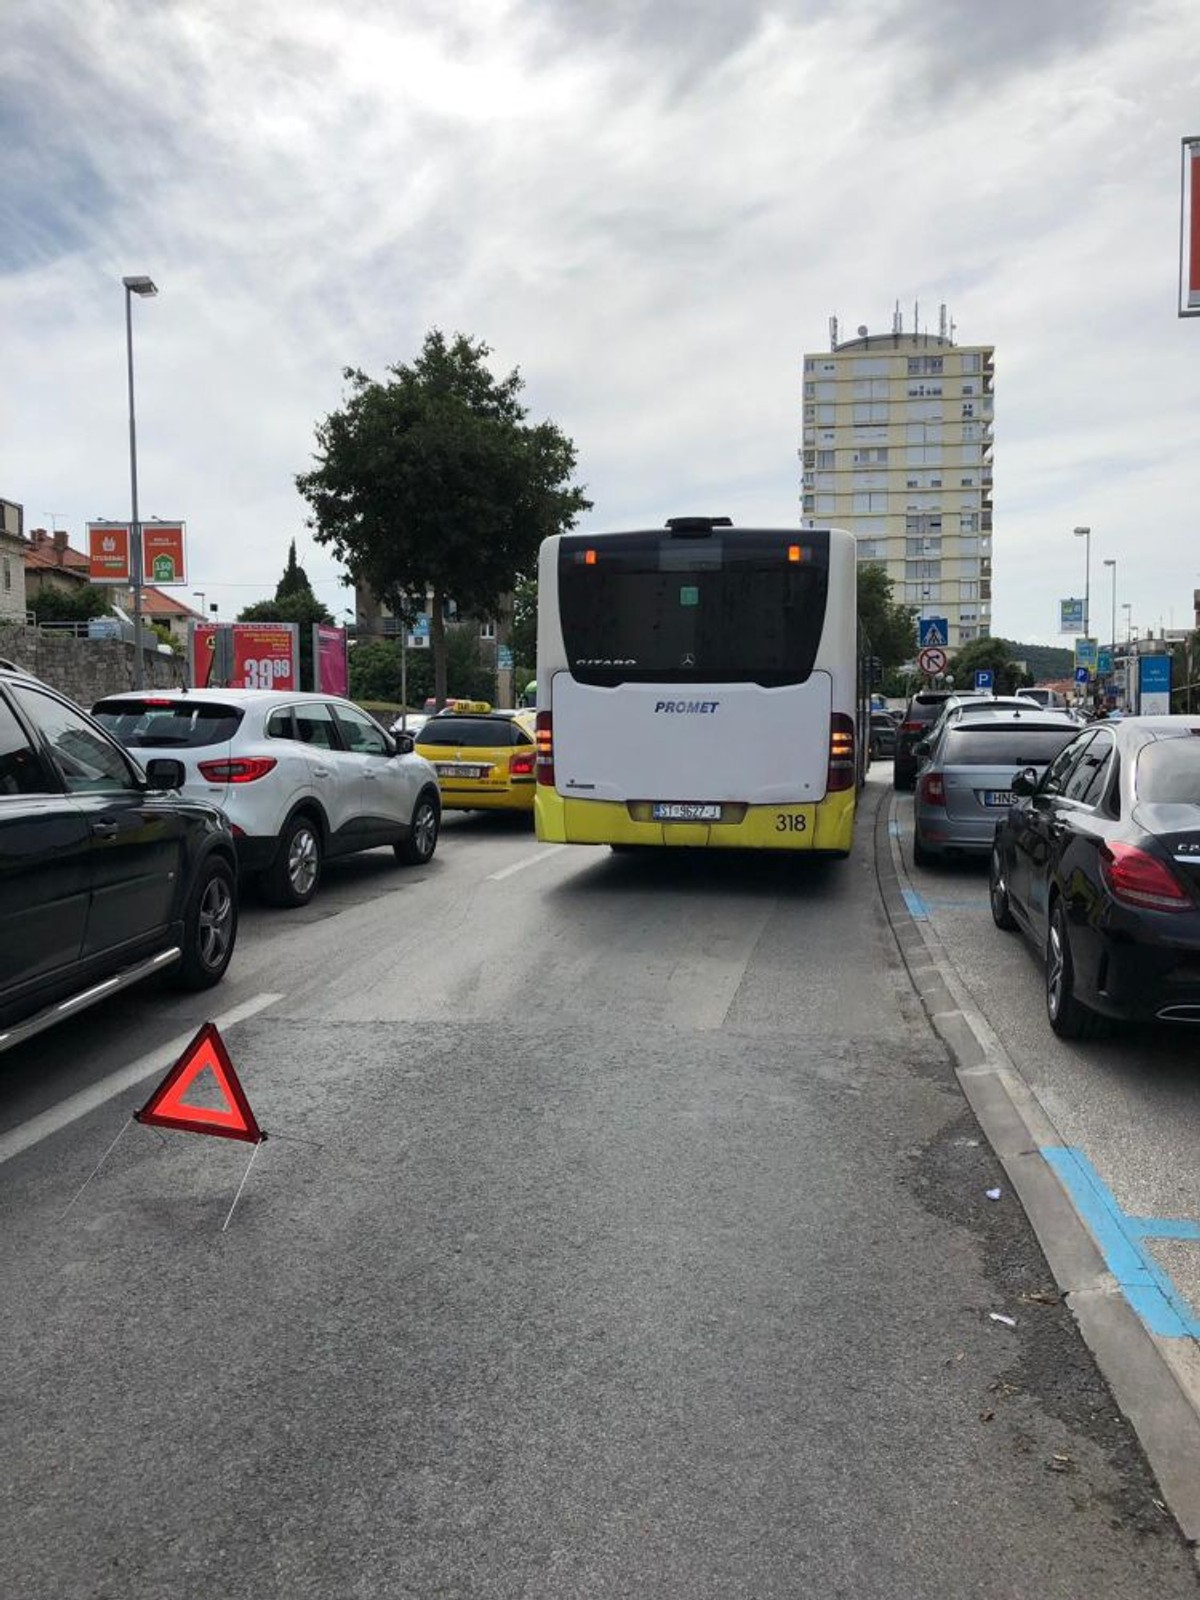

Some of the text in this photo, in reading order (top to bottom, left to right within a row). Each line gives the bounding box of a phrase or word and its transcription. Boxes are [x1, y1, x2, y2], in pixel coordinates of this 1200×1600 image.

[155, 562, 171, 571] 150
[979, 673, 989, 685] P
[655, 701, 719, 714] PROMET
[776, 814, 806, 832] 318
